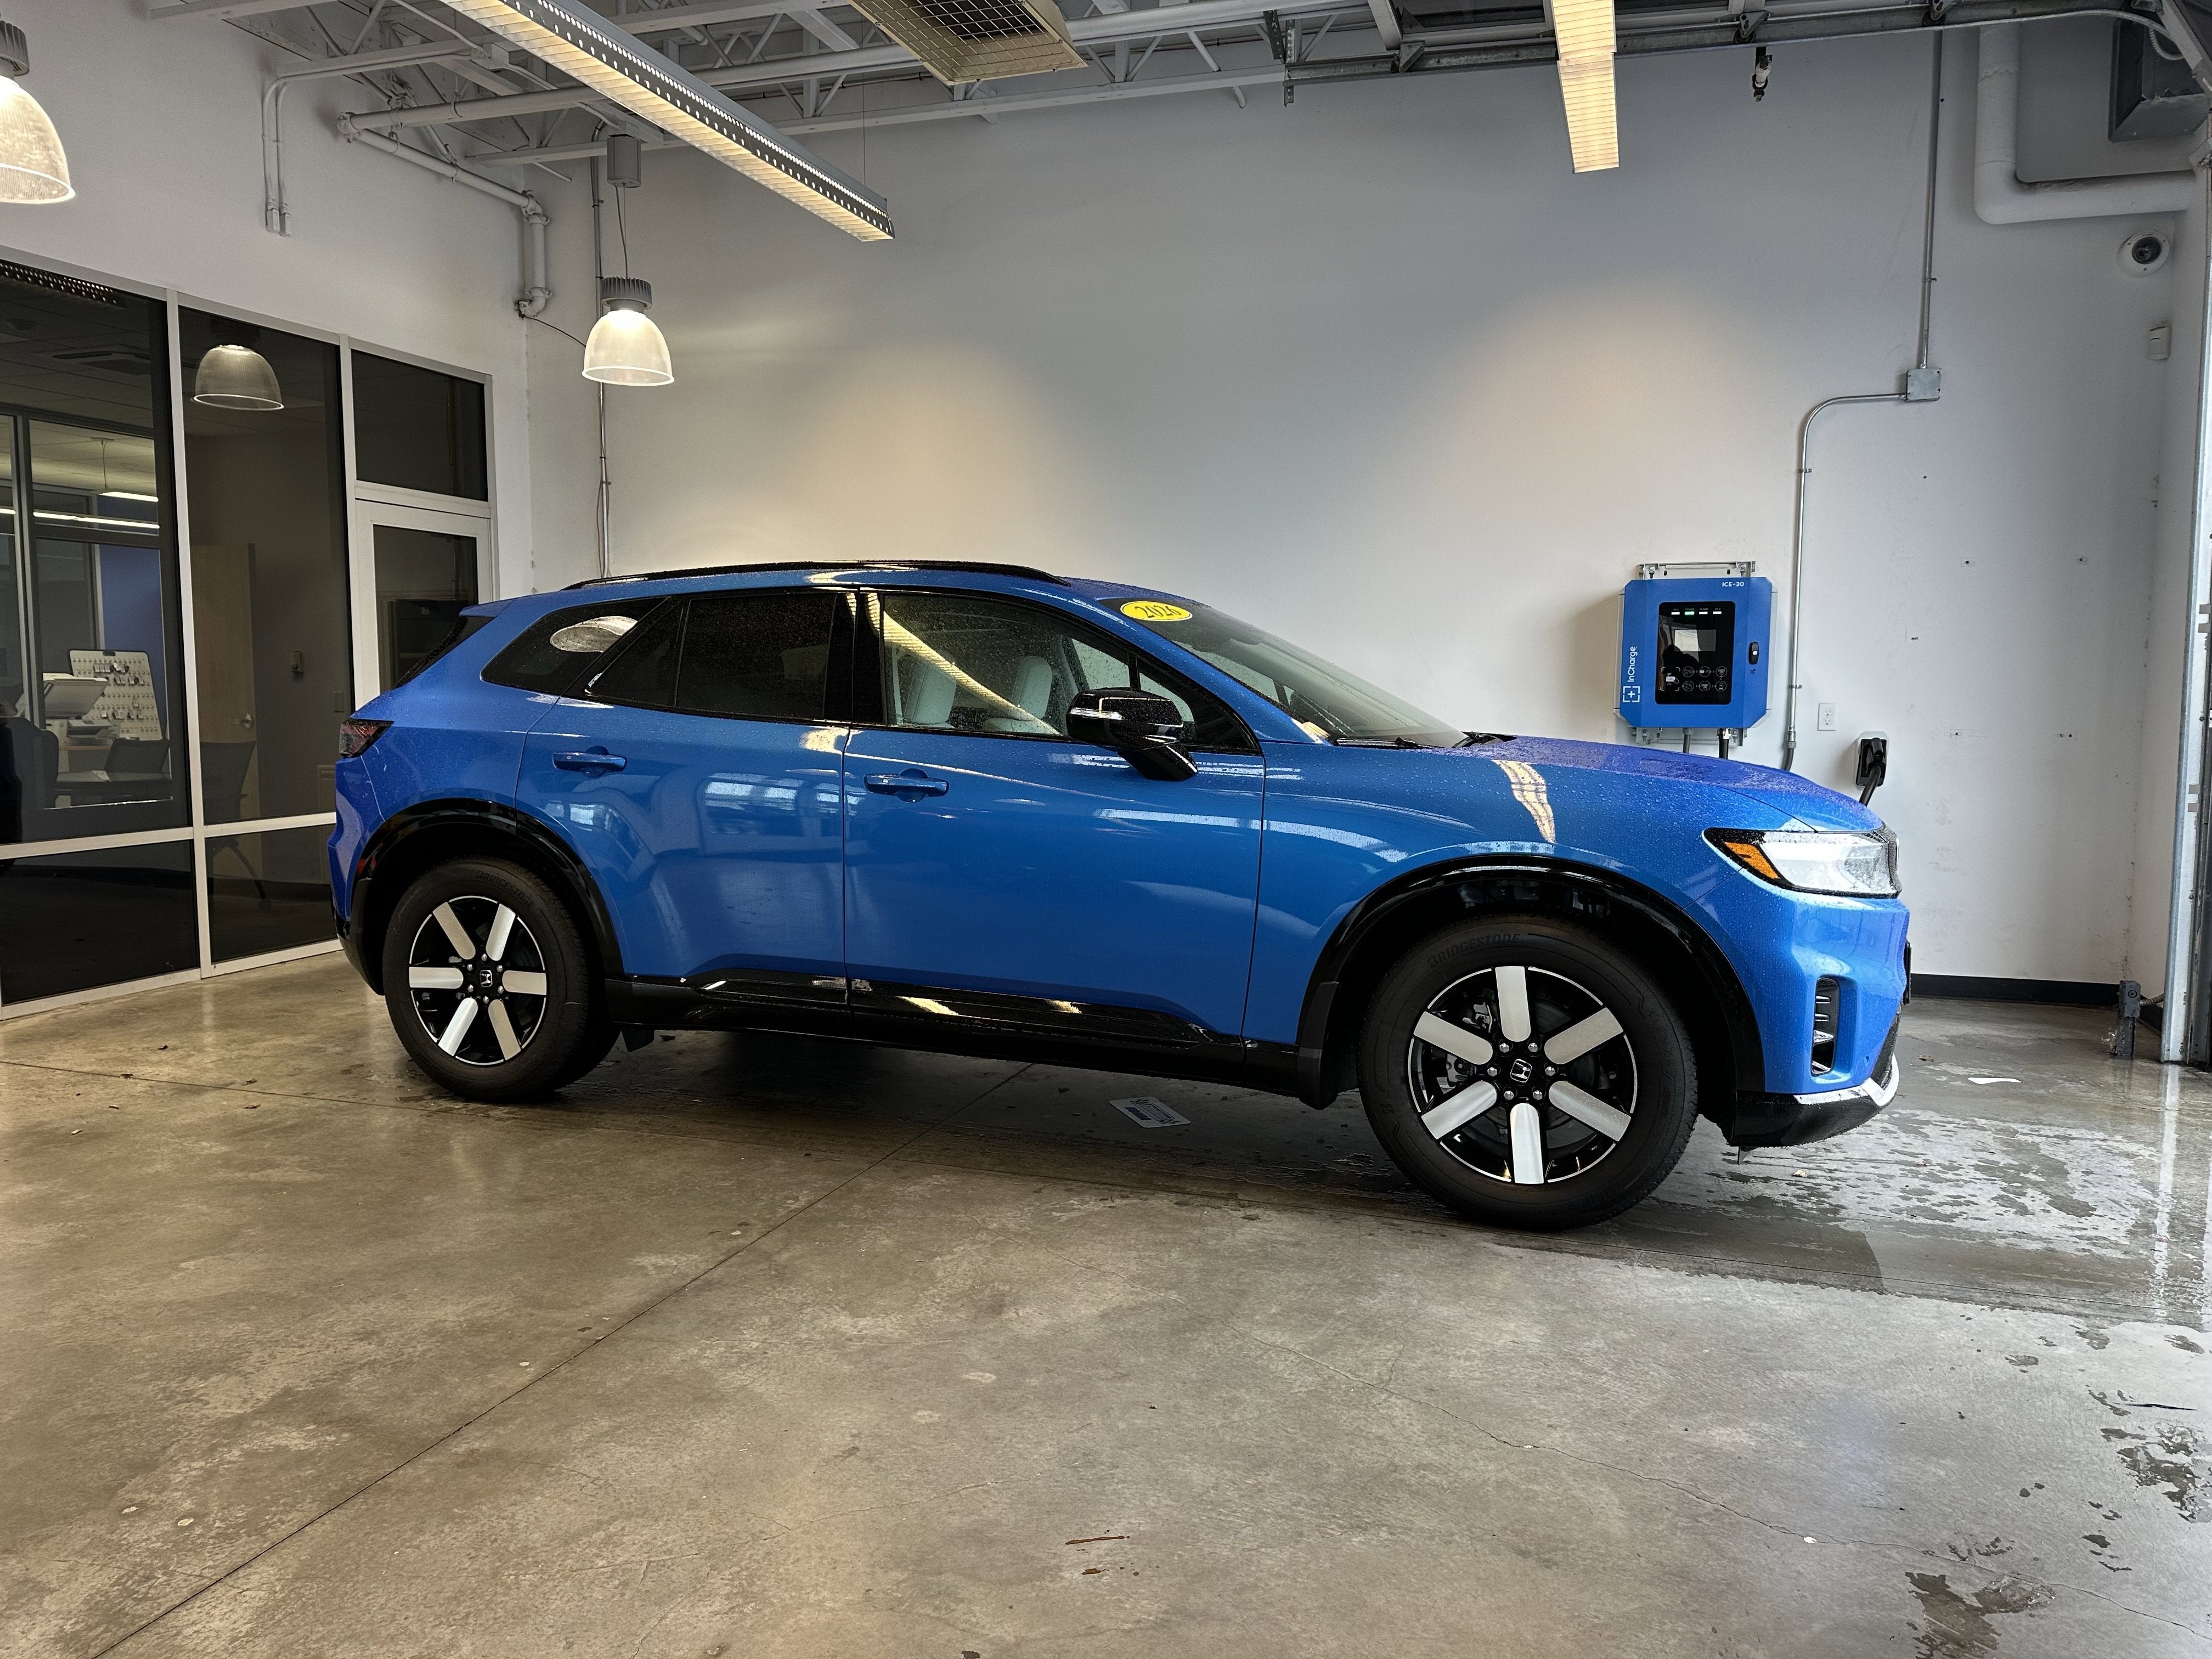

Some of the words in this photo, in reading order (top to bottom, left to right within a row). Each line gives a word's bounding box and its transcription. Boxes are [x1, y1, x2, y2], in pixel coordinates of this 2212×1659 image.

[1135, 605, 1182, 618] 2026
[1627, 646, 1638, 682] InCharge
[1427, 933, 1521, 969] BRIDGESTONE
